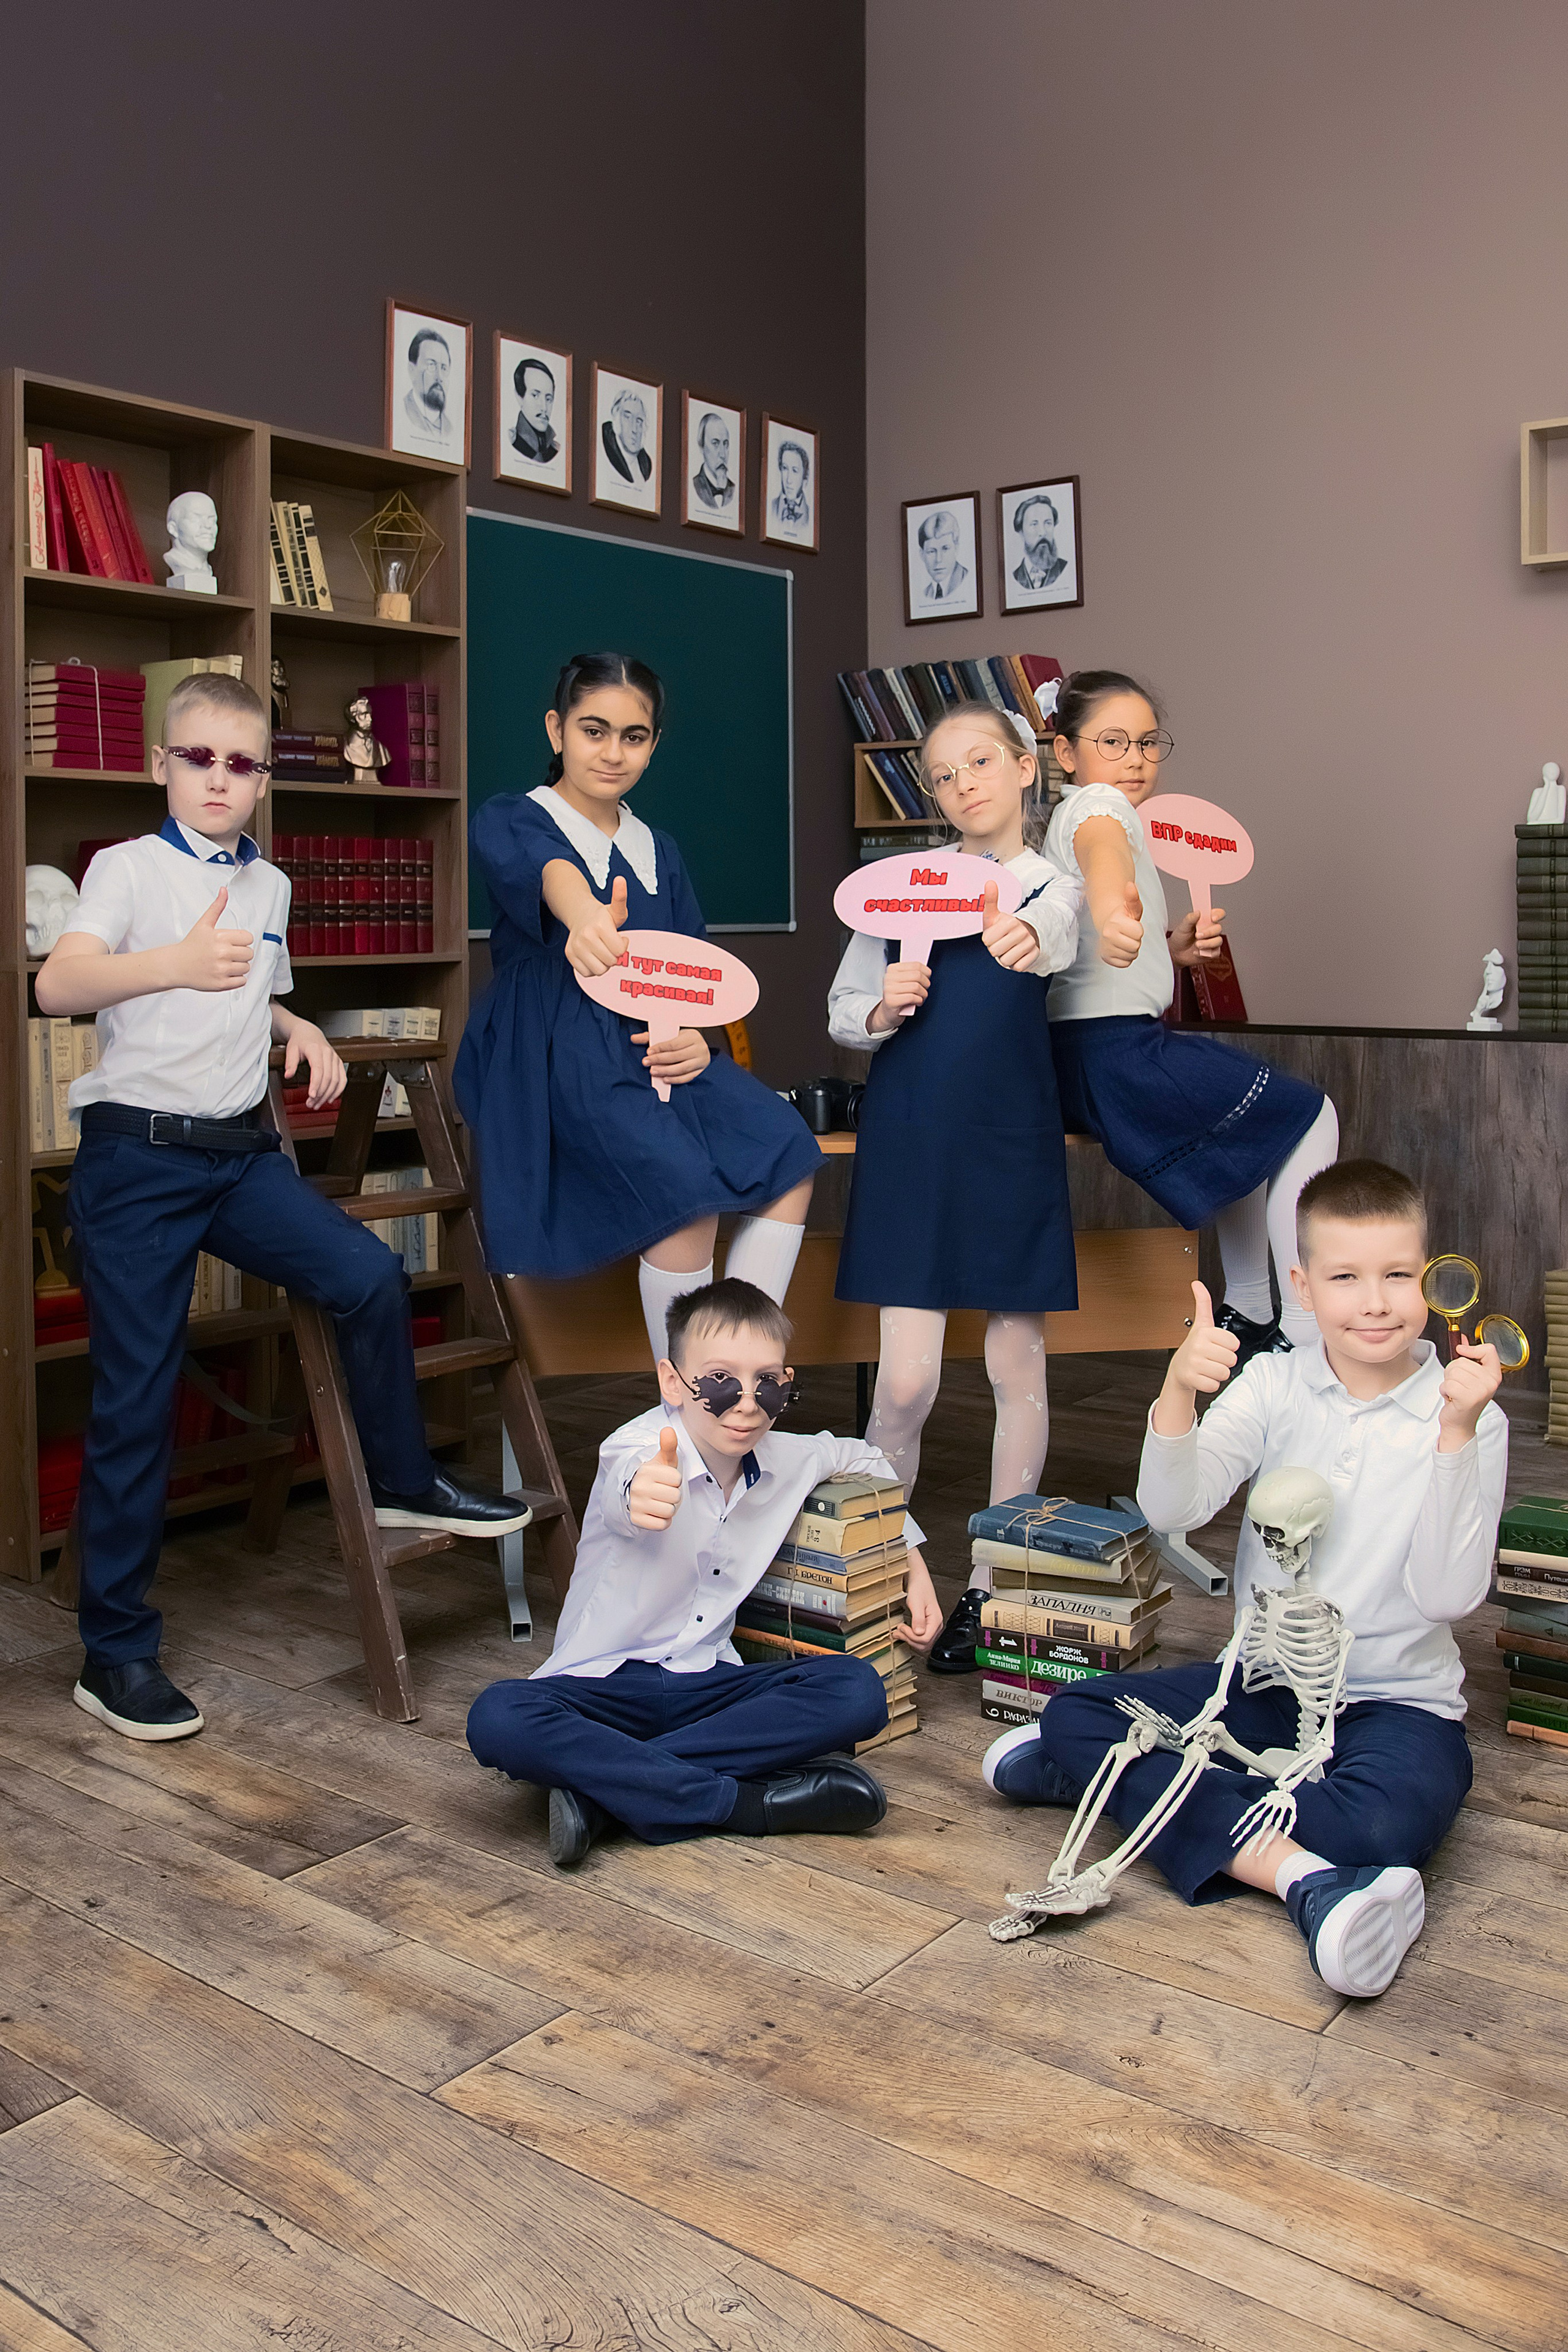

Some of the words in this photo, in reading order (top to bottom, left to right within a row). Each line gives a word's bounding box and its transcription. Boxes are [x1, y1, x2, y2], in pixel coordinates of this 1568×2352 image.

[1151, 820, 1183, 842] ВПР
[1185, 831, 1237, 853] сдадим
[910, 869, 948, 886] Мы
[864, 894, 984, 913] счастливы!
[631, 956, 664, 974] тут
[666, 962, 722, 981] самая
[620, 979, 714, 1005] красивая!
[801, 1571, 833, 1584] БРЕТОН
[1028, 1595, 1096, 1615] ЗАПАДНЯ
[987, 1652, 1021, 1664] Анна-Мария
[1049, 1651, 1089, 1664] БОРДОНОВ
[1056, 1645, 1082, 1656] ЖОРЖ
[989, 1659, 1020, 1670] ЗЕЛИНКО
